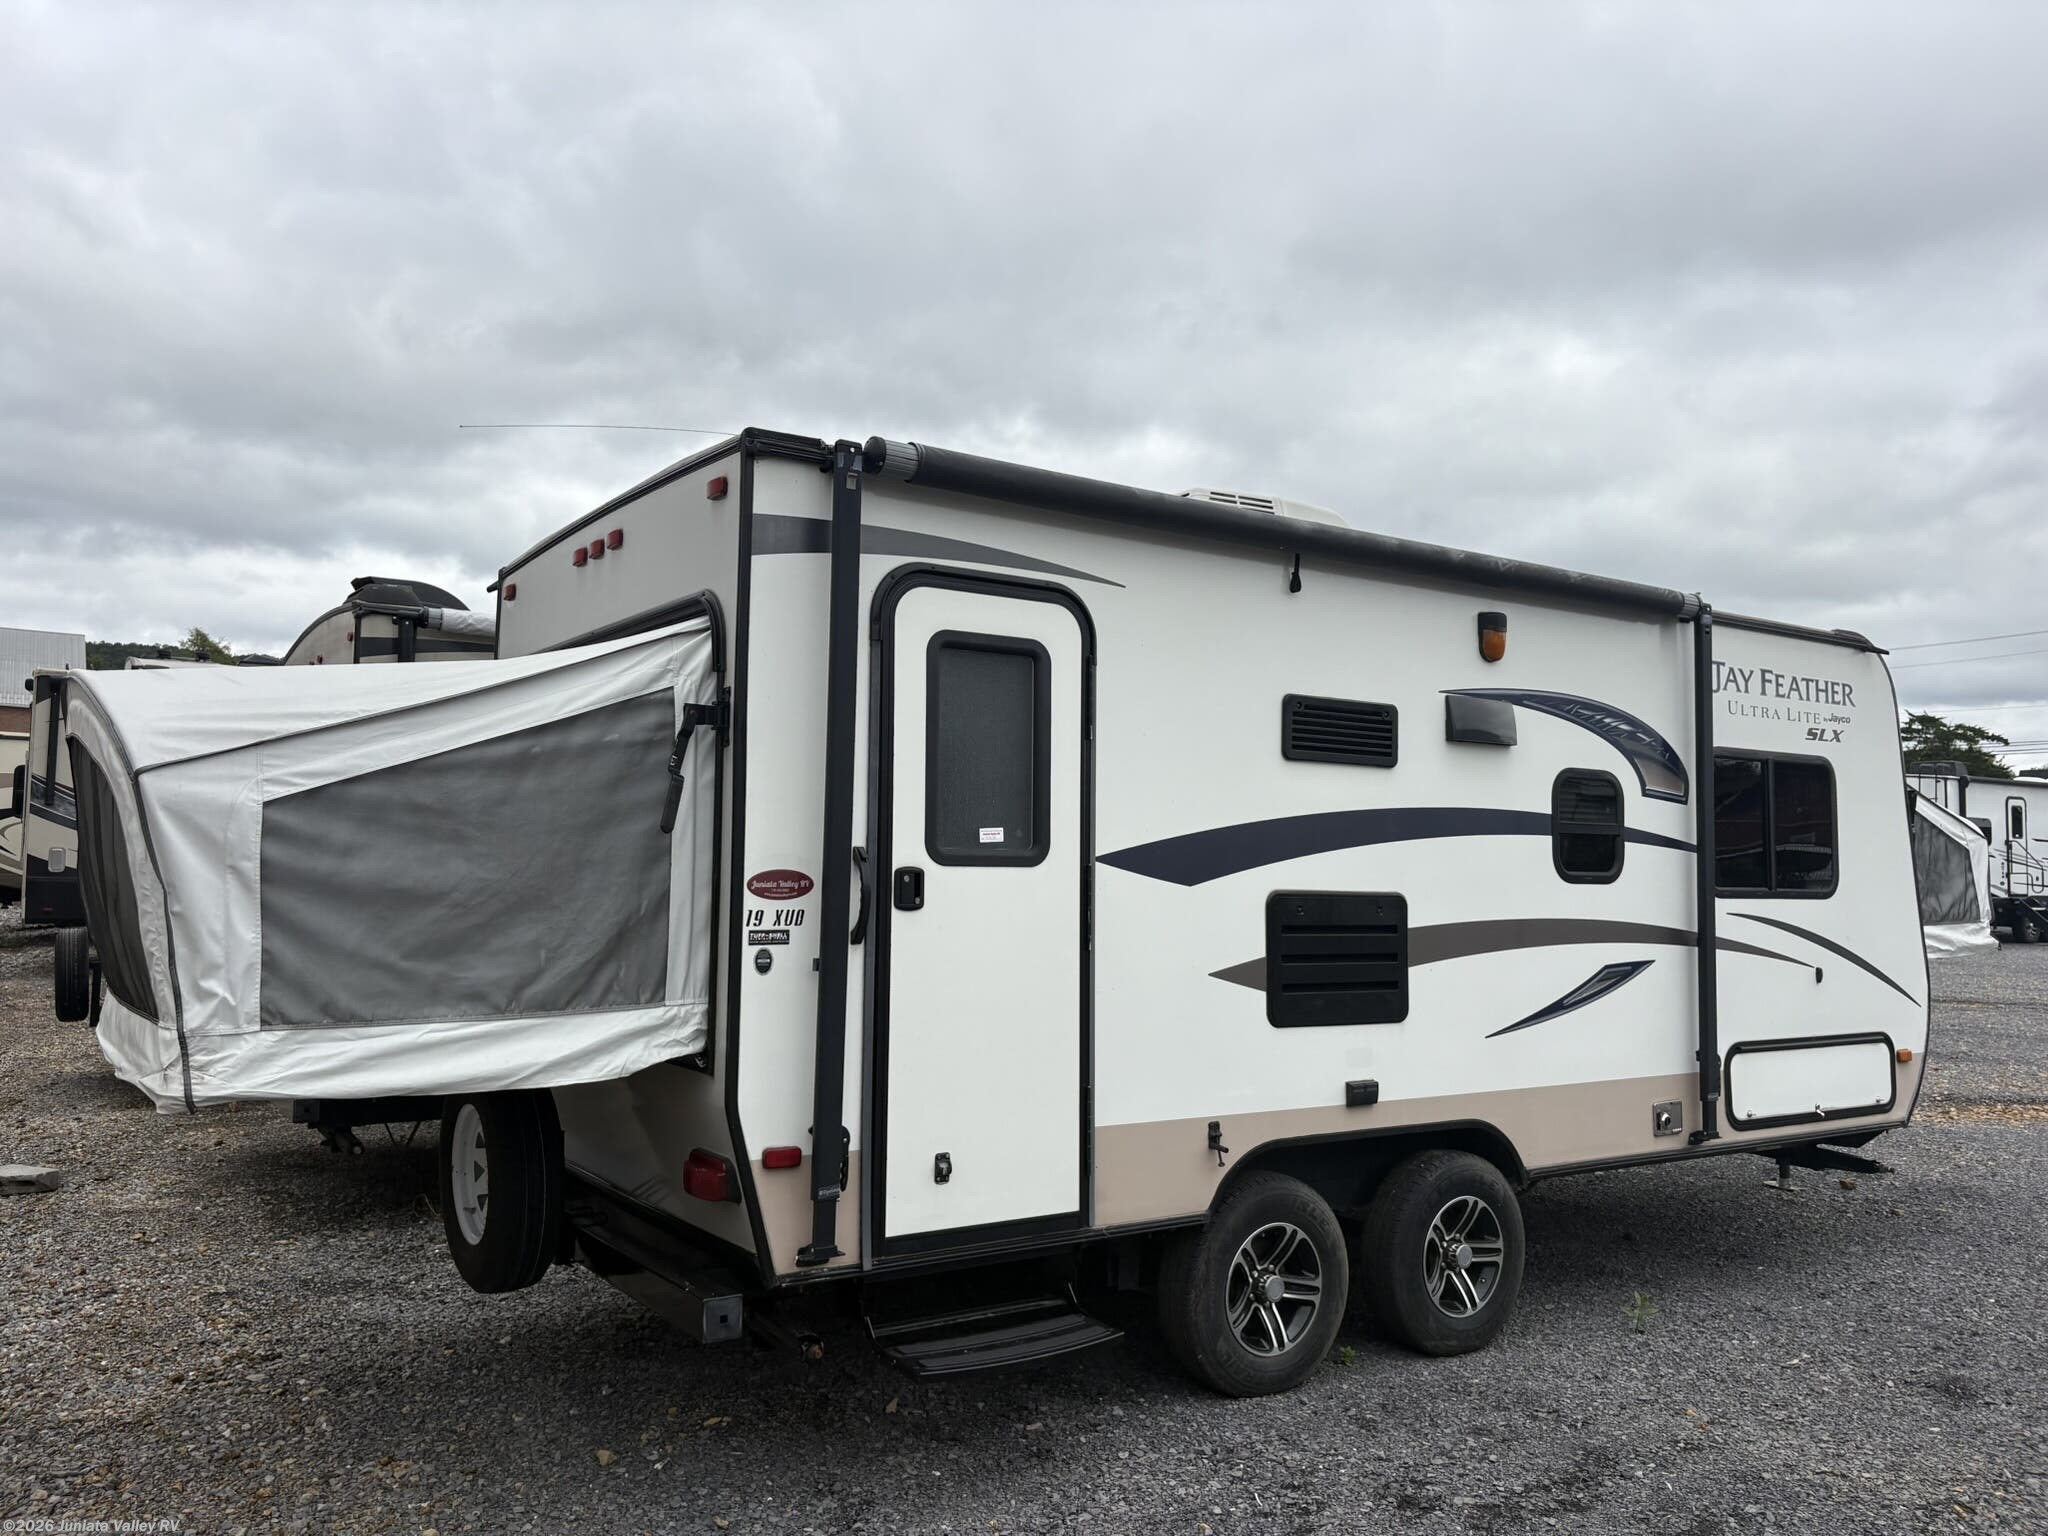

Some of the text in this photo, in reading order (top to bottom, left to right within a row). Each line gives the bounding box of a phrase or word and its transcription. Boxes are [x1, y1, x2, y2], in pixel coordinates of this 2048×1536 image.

[1711, 660, 1856, 707] JAY FEATHER
[1728, 700, 1781, 720] ULTRA
[1787, 707, 1821, 725] LITE
[1828, 712, 1851, 725] Jayco
[1805, 727, 1844, 743] SLX
[745, 909, 764, 927] 19
